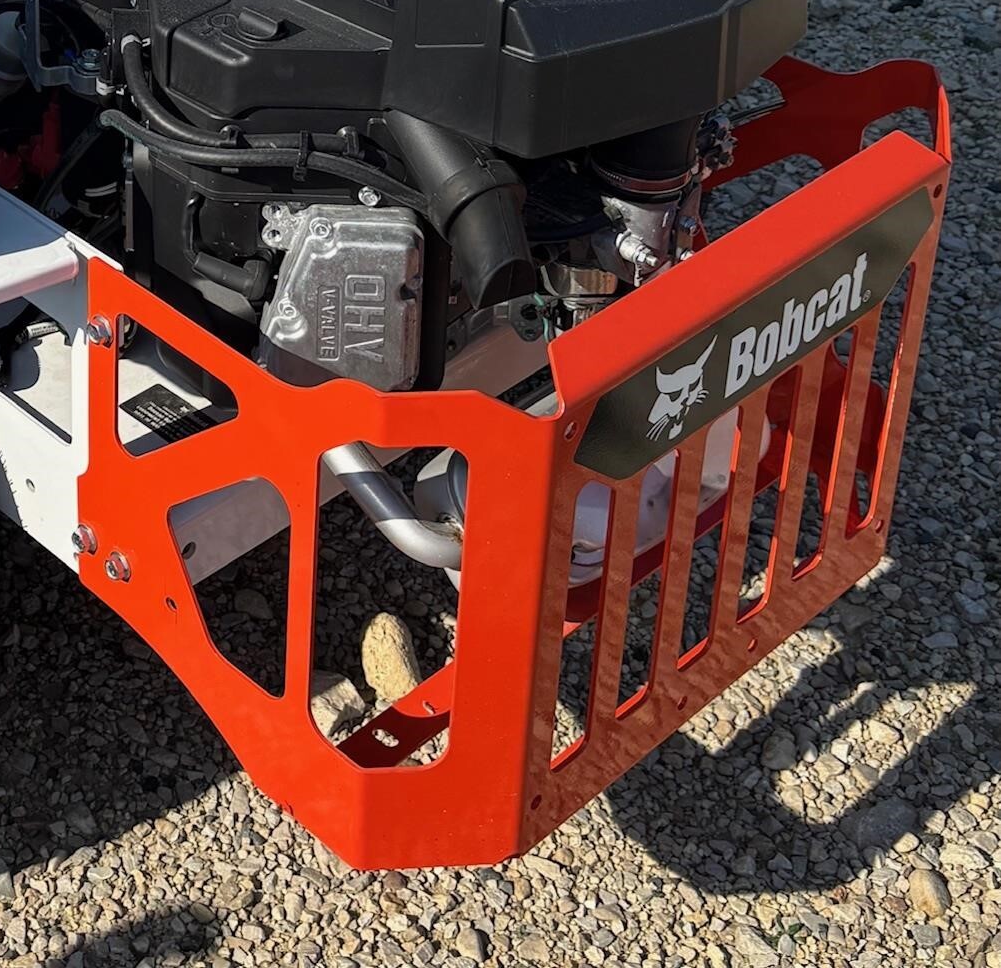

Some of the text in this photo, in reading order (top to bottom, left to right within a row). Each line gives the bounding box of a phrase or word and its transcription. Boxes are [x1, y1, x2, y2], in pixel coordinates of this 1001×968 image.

[320, 289, 337, 358] V-VALVE
[344, 275, 386, 363] OHV
[724, 252, 868, 399] Bobcat
